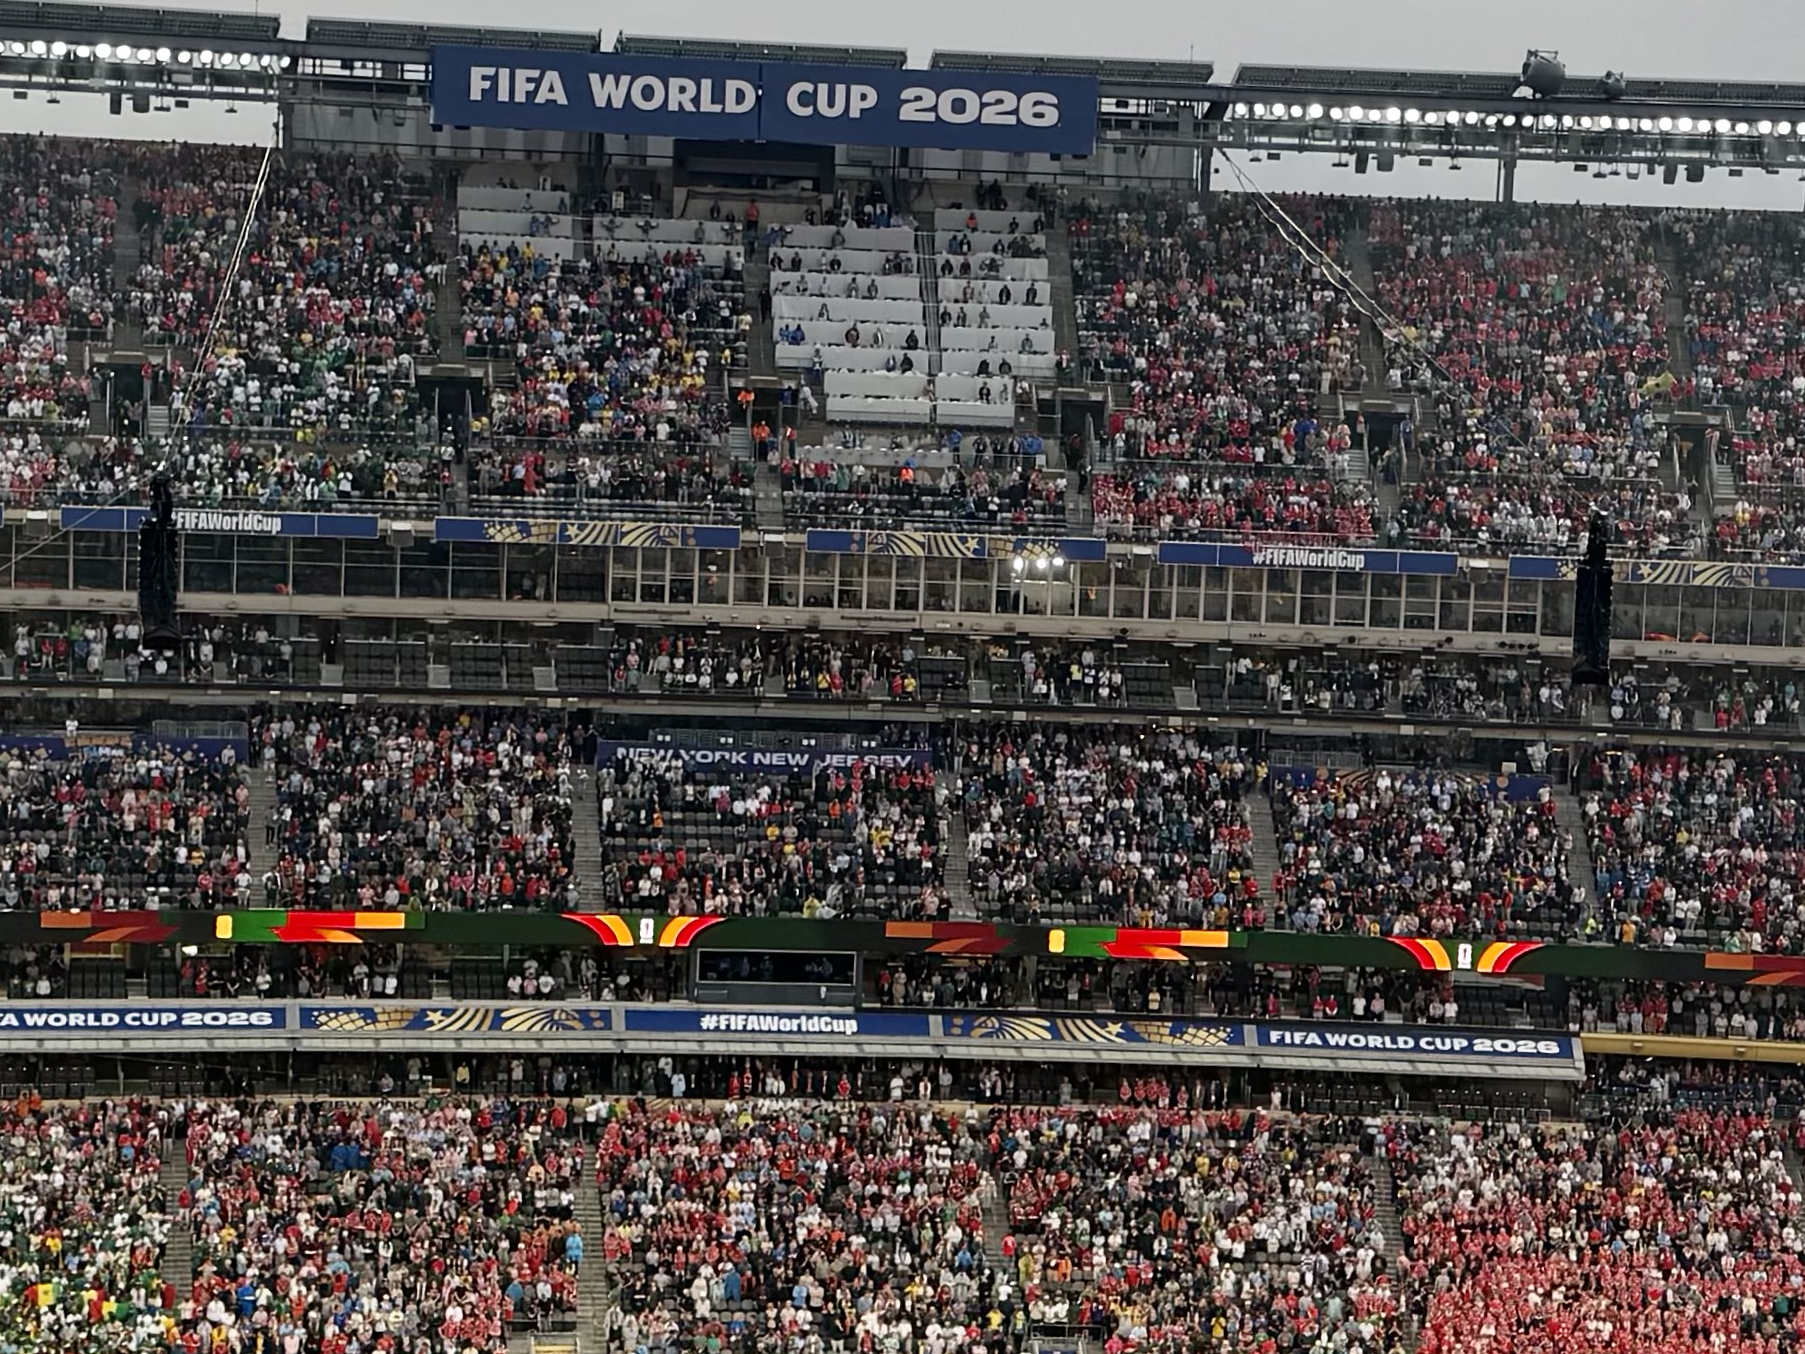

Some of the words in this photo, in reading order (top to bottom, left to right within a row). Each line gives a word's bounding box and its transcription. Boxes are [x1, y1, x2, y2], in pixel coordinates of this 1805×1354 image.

[469, 66, 569, 106] FIFA
[588, 72, 757, 115] WORLD
[786, 81, 879, 119] CUP
[899, 87, 1060, 127] 2026
[171, 511, 281, 534] FIFAWorldCup
[1252, 547, 1365, 571] #FIFAWorldCup
[679, 749, 747, 765] YORK
[753, 752, 809, 767] NEW
[25, 1012, 119, 1027] WORLD
[124, 1012, 178, 1026] CUP
[181, 1011, 273, 1026] 2026
[700, 1014, 858, 1036] #FIFAWorldCup
[1269, 1030, 1323, 1046] FIFA
[1326, 1033, 1415, 1050] WORLD
[1419, 1036, 1469, 1051] CUP
[1472, 1037, 1560, 1054] 2026
